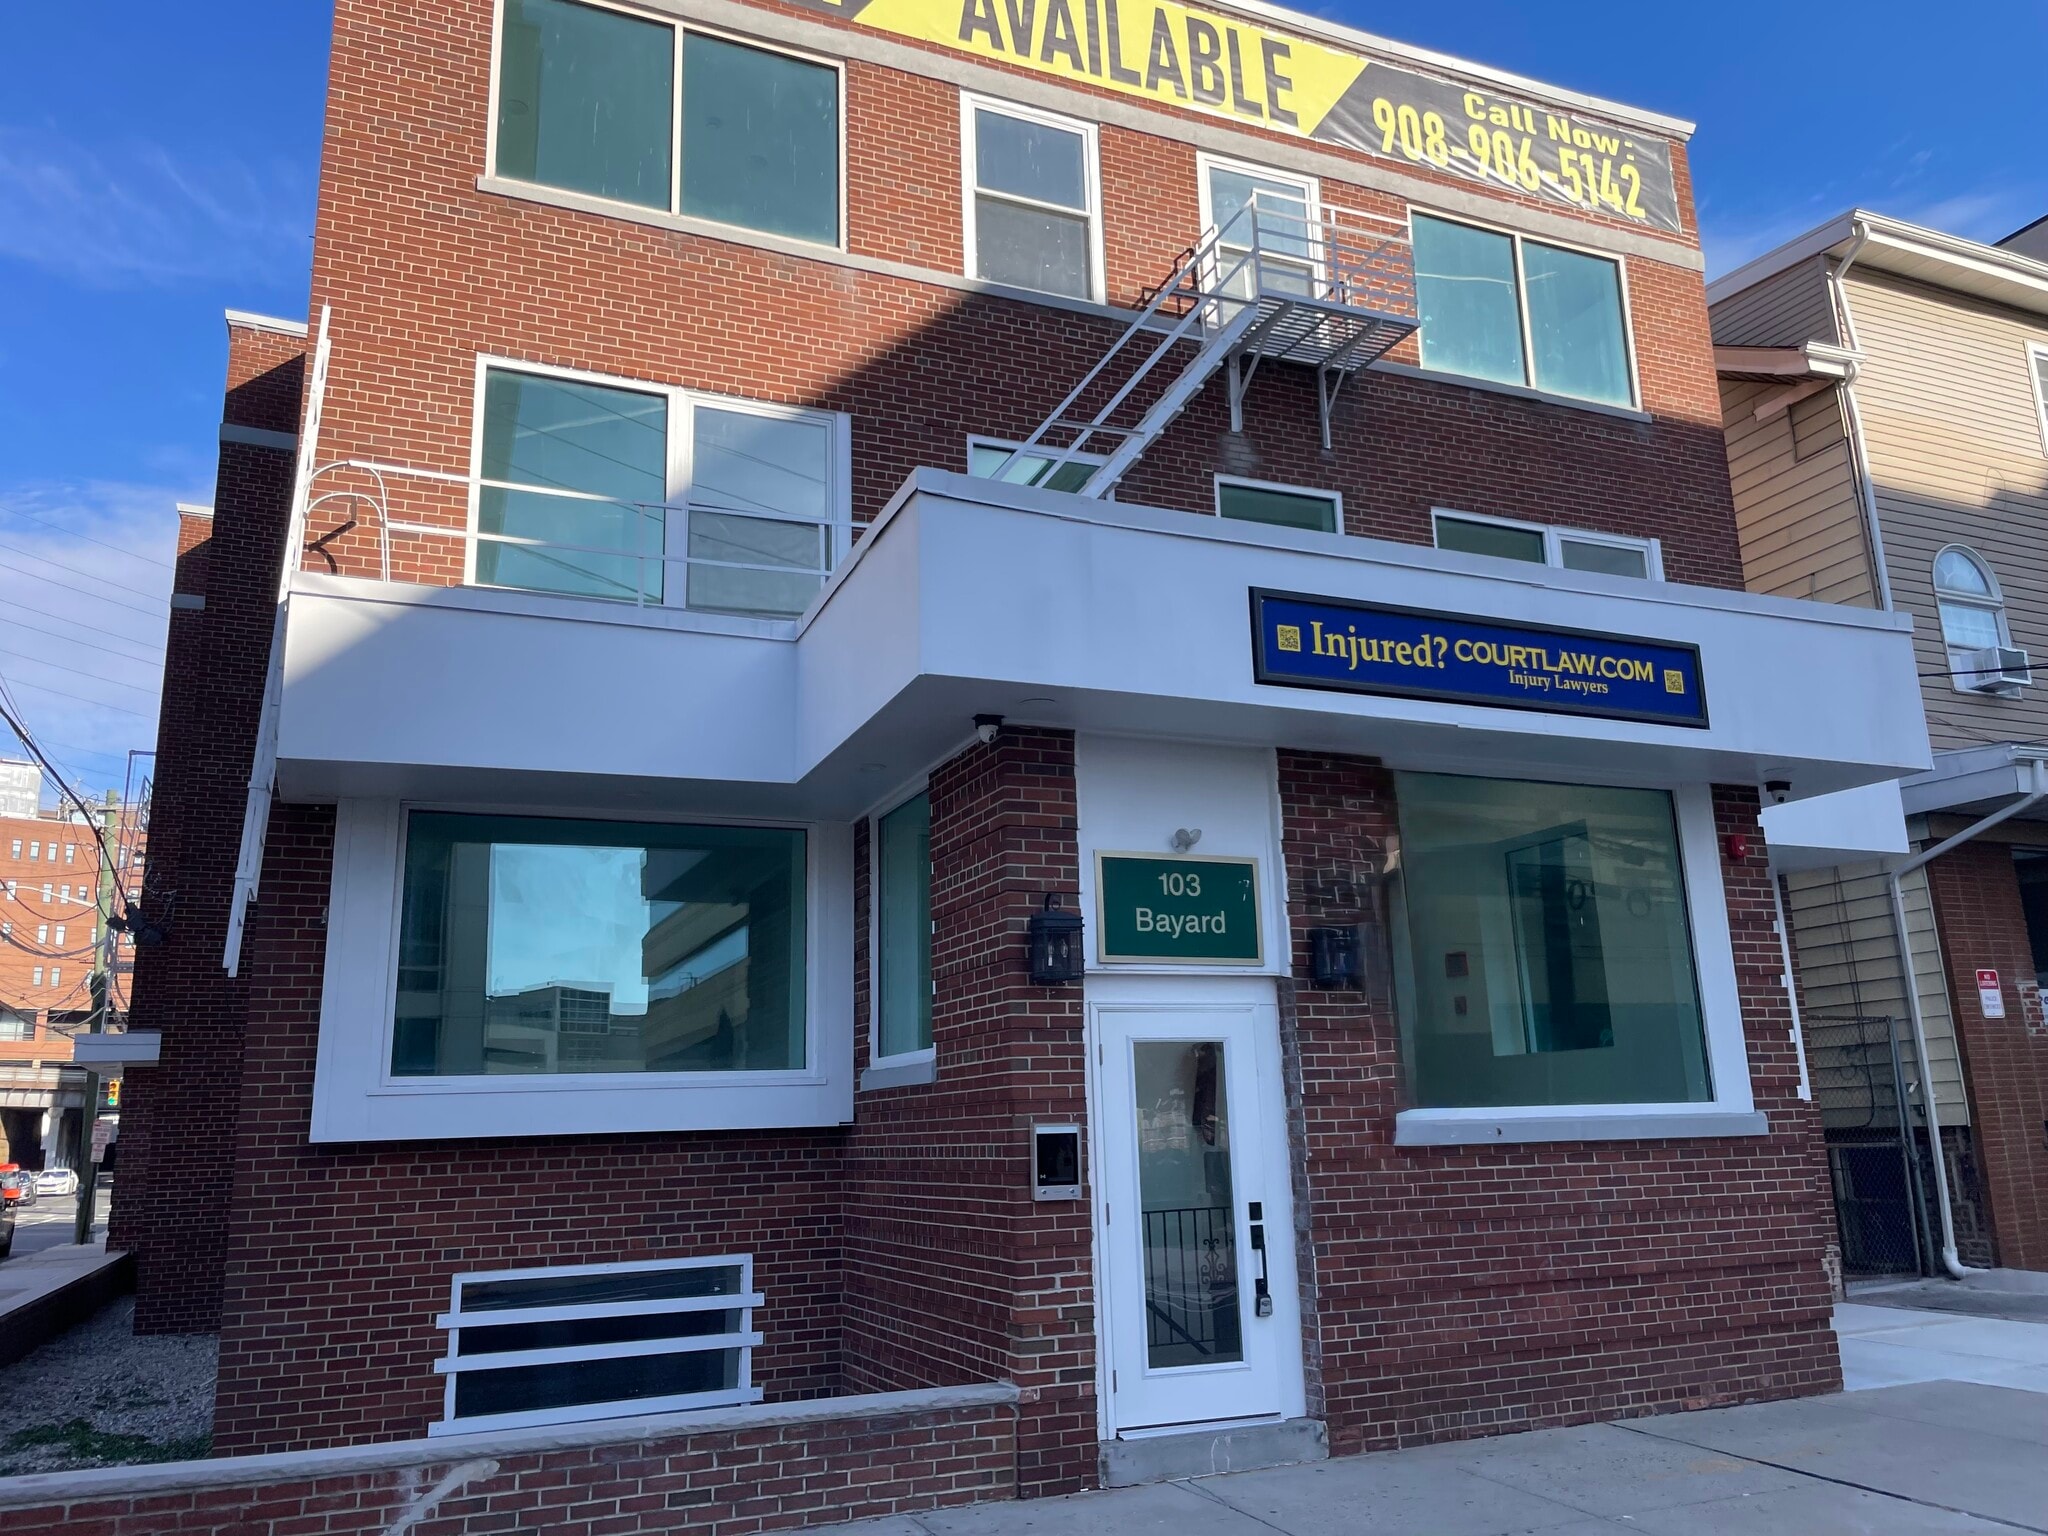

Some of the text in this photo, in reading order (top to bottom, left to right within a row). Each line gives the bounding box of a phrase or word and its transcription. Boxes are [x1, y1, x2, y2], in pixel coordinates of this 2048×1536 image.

[958, 0, 1299, 128] AVAILABLE
[1373, 97, 1646, 219] 908-906-5142
[1463, 93, 1635, 161] Call Now:
[1310, 621, 1655, 683] Injured? COURTLAW.COM
[1508, 669, 1609, 695] Injury Lawyers
[1158, 872, 1201, 897] 103
[1135, 907, 1226, 939] Bayard
